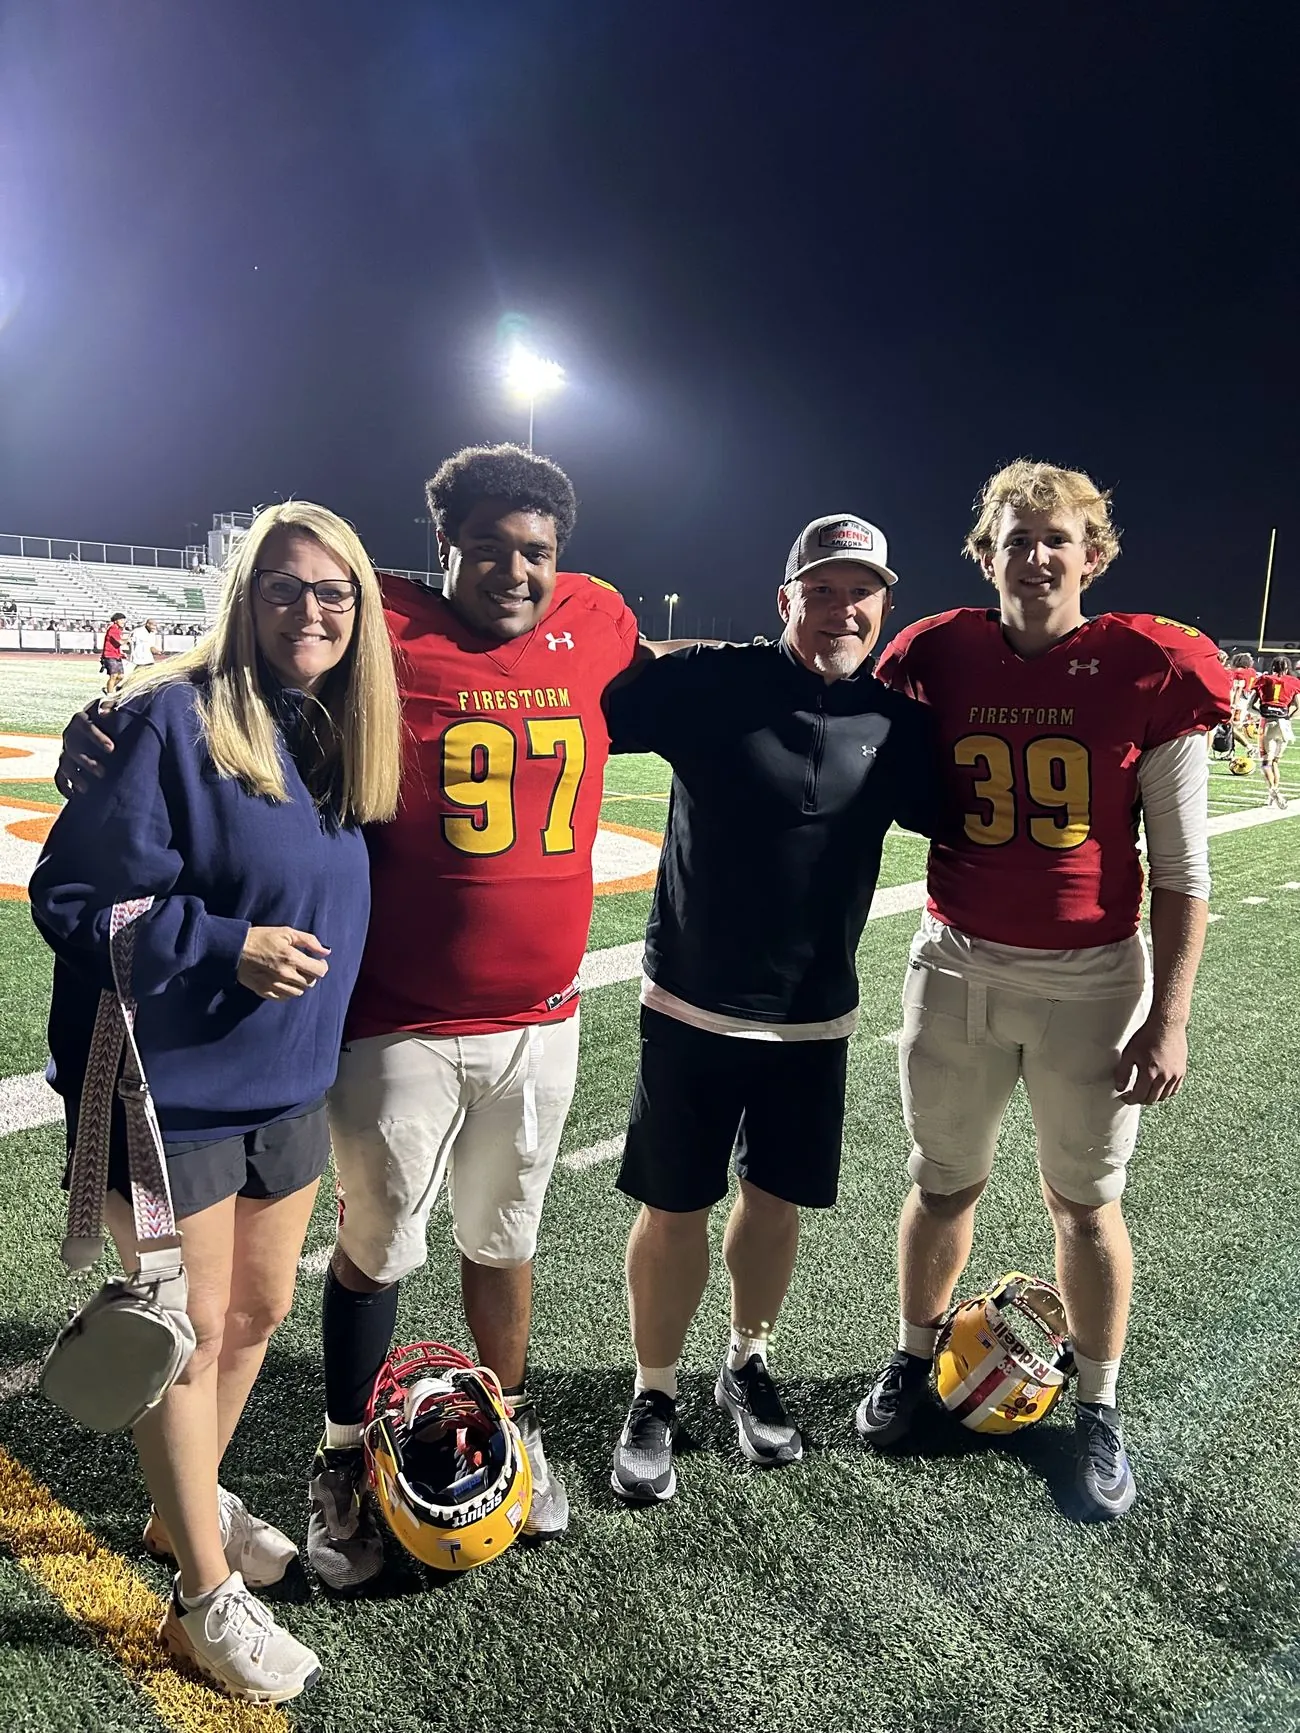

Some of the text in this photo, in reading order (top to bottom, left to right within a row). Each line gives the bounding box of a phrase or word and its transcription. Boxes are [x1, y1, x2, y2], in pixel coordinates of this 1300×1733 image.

[824, 531, 869, 543] OENIX
[457, 687, 571, 711] FIRESTORM
[968, 706, 1075, 726] FIRESTORM
[440, 716, 587, 858] 97
[951, 732, 1093, 848] 39
[993, 1321, 1051, 1380] Riddell
[452, 1491, 502, 1528] schutt
